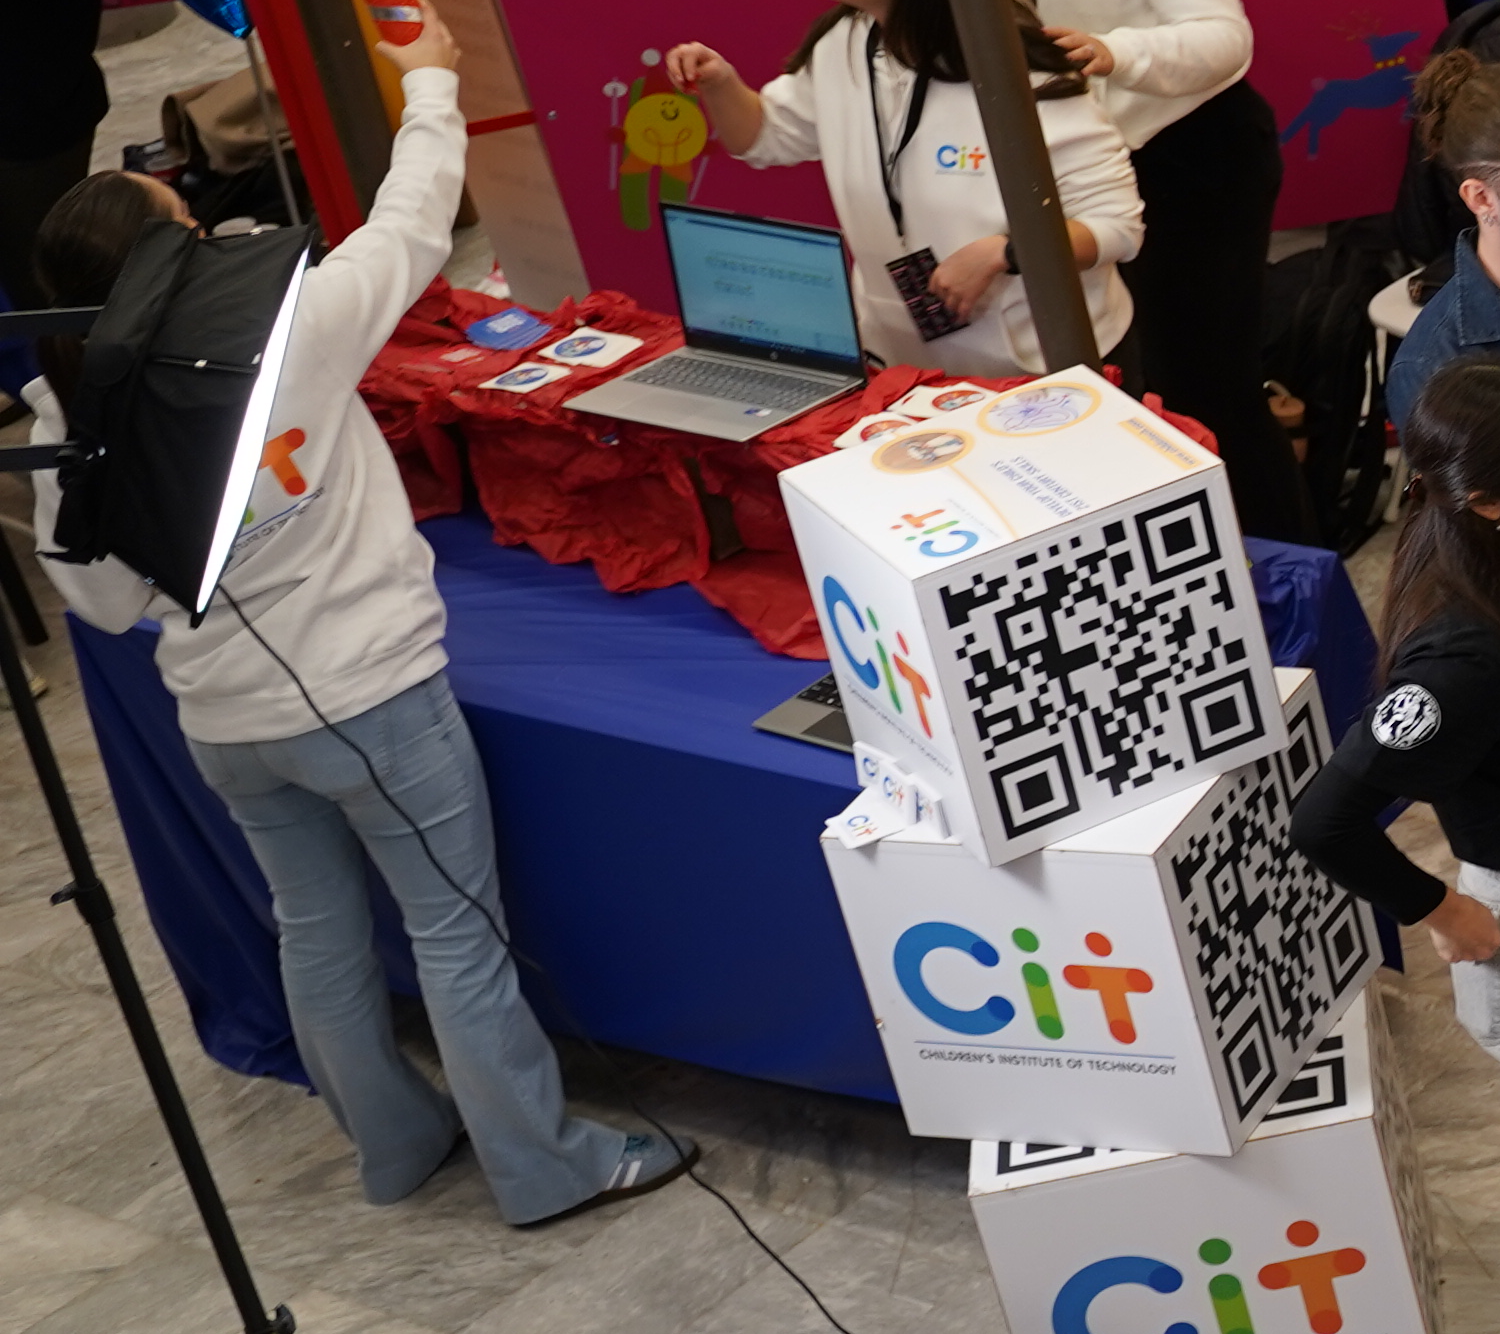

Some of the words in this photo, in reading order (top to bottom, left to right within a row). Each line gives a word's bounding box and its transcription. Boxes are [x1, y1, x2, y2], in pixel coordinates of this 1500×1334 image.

[918, 1047, 996, 1065] CHILDREN'S
[998, 1052, 1063, 1069] INSTITUTE
[1065, 1056, 1084, 1069] OF
[1087, 1058, 1177, 1076] TECHNOLOGY
